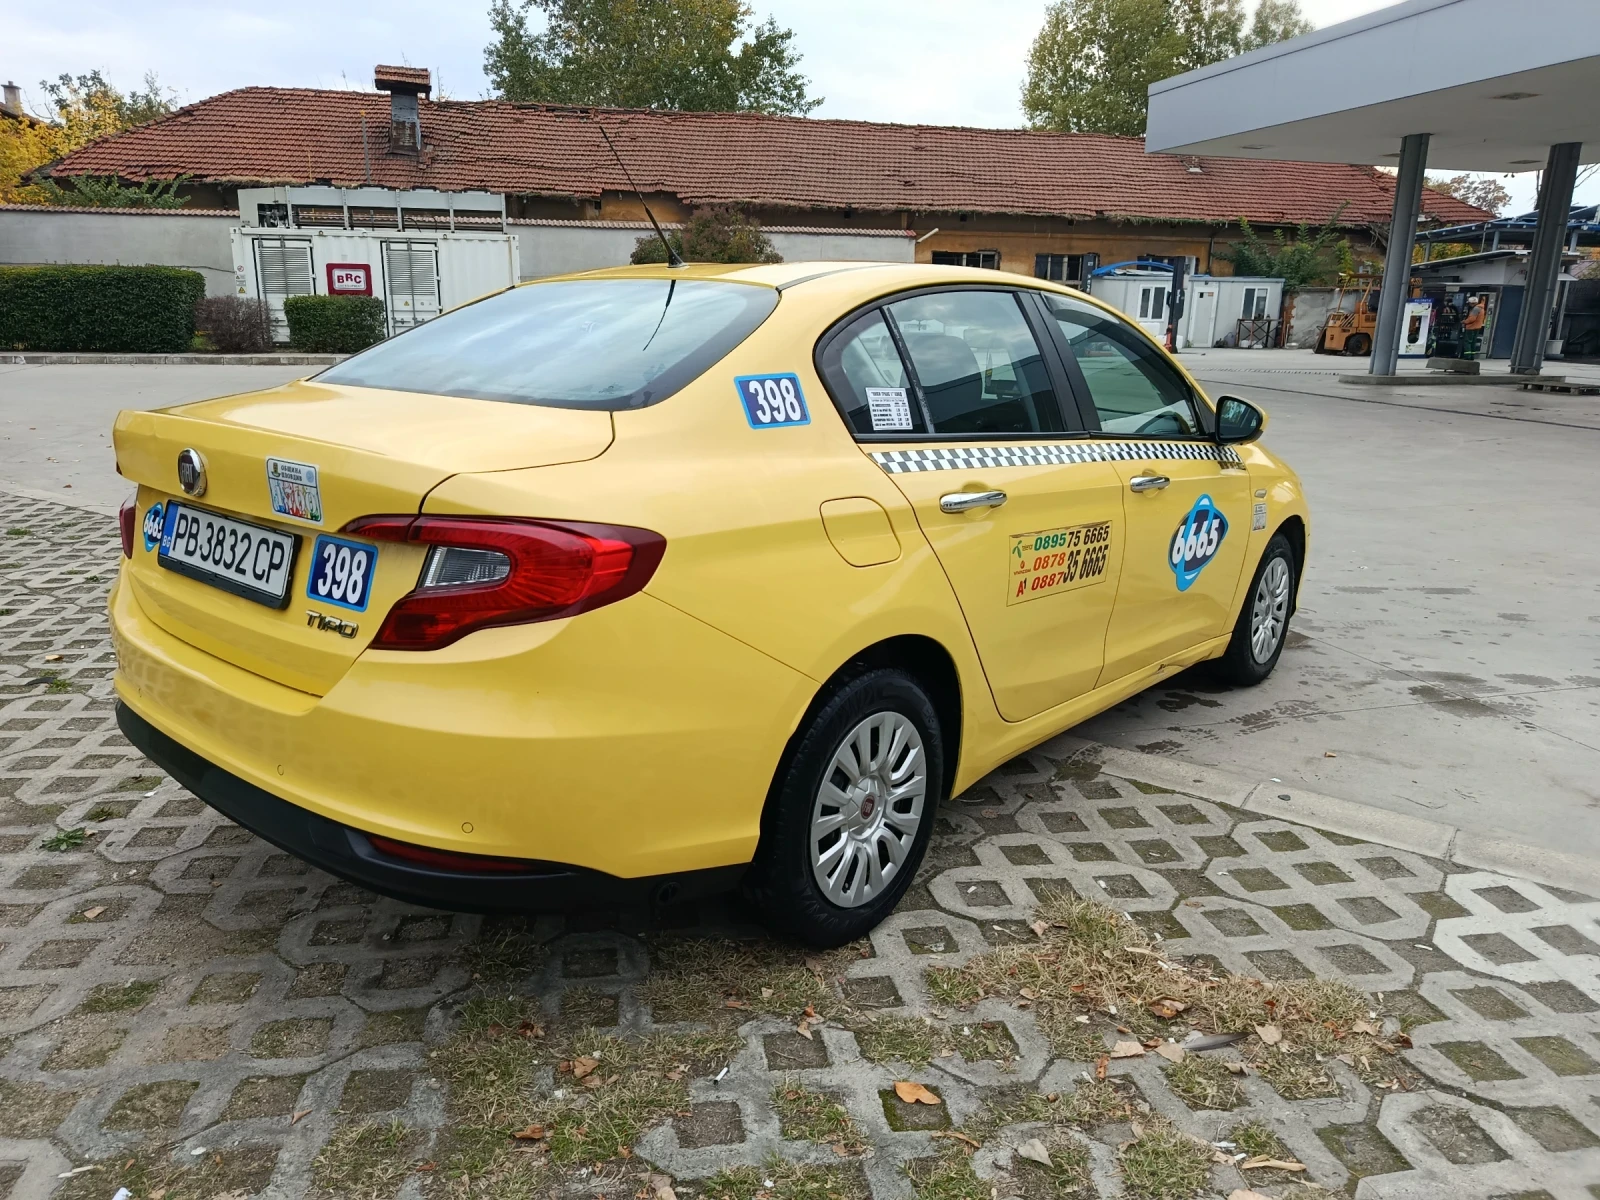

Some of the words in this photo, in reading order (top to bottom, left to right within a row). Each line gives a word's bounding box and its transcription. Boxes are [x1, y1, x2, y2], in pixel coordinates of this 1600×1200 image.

[337, 273, 362, 284] BRC
[748, 378, 801, 424] 398
[162, 535, 172, 548] BG
[1033, 532, 1067, 551] 0895
[1083, 525, 1110, 545] 6665
[1172, 518, 1221, 565] 6665
[317, 543, 368, 604] 398
[1033, 552, 1066, 572] 0878
[1062, 549, 1081, 584] 35
[1079, 544, 1109, 580] 6665
[1031, 571, 1065, 591] 0887
[306, 609, 359, 639] TIPO
